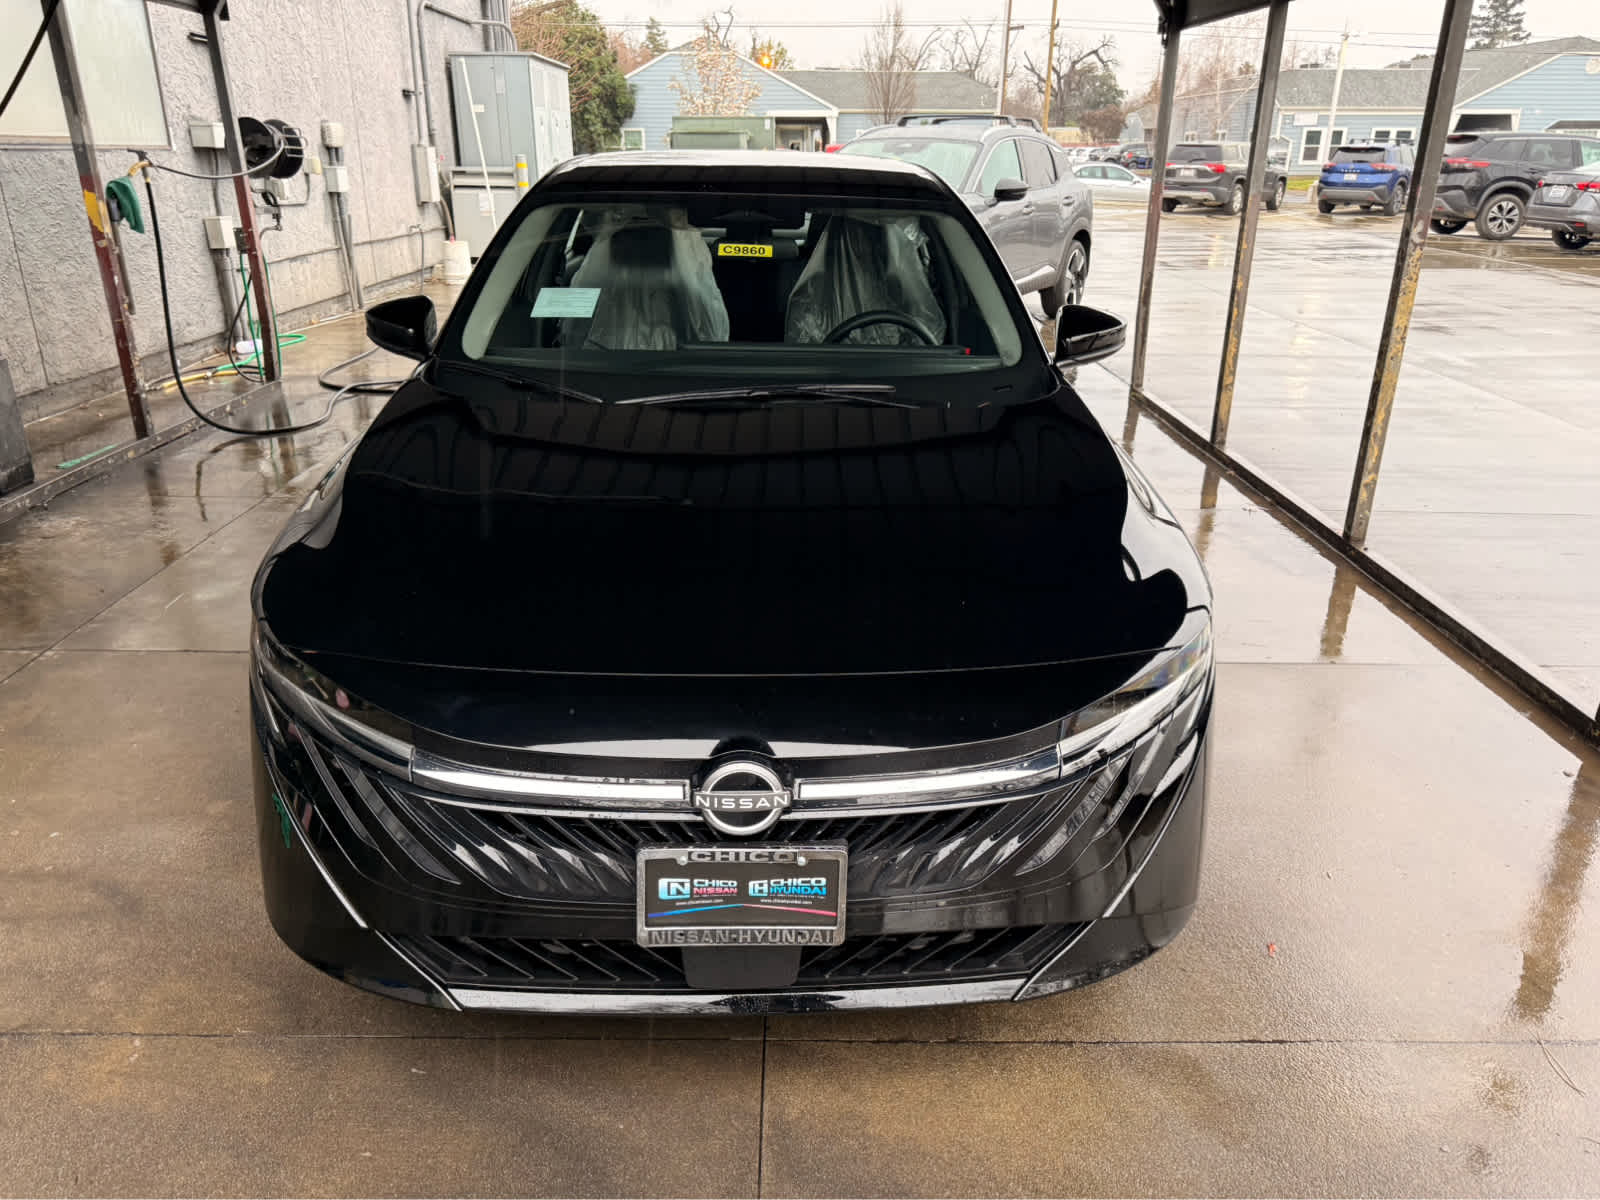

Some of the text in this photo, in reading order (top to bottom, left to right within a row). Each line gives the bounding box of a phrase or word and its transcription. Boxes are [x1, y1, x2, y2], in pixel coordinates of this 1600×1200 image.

[723, 245, 766, 255] C9860
[695, 794, 789, 809] NISSAN
[690, 851, 795, 861] CHICO
[693, 879, 738, 887] CHICO
[769, 877, 827, 886] CHICO
[693, 887, 738, 895] NISSAN
[769, 886, 827, 896] HYUNDAI
[651, 930, 834, 944] NISSAN-HYUNDAI
